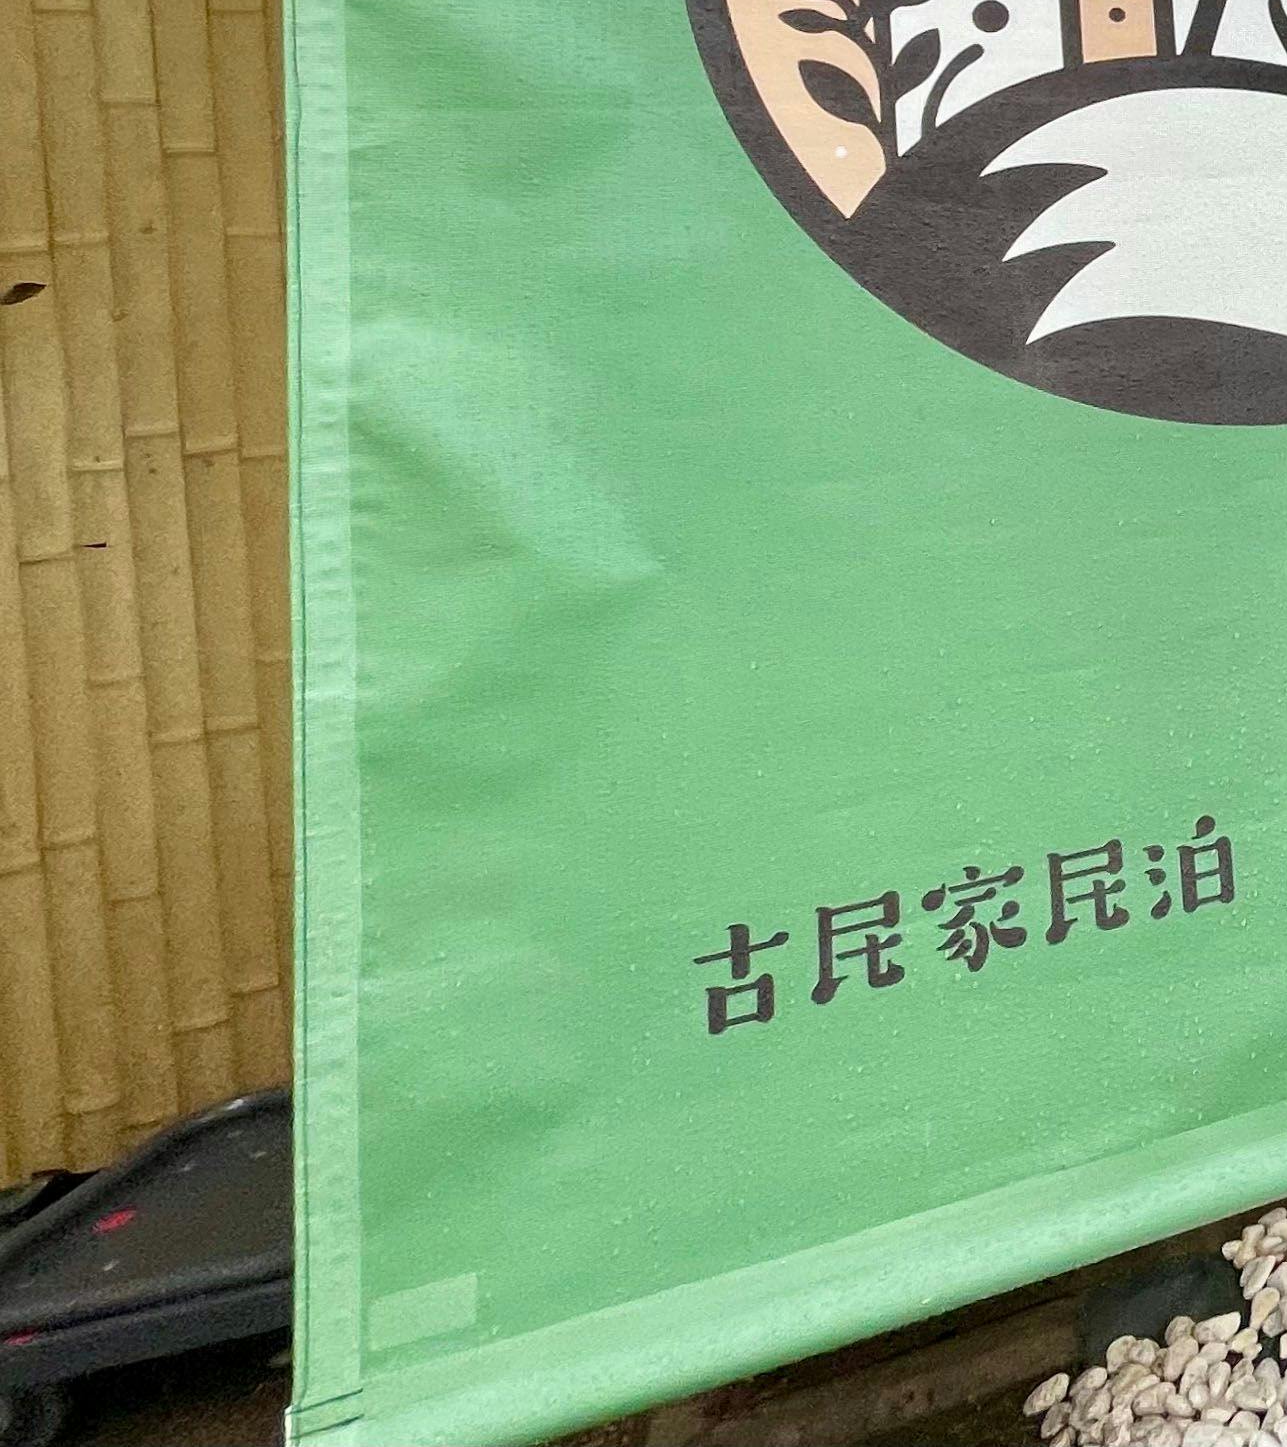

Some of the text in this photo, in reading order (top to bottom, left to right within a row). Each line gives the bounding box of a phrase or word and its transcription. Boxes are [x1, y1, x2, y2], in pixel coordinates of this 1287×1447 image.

[692, 814, 1236, 1035] 古民家民泊
